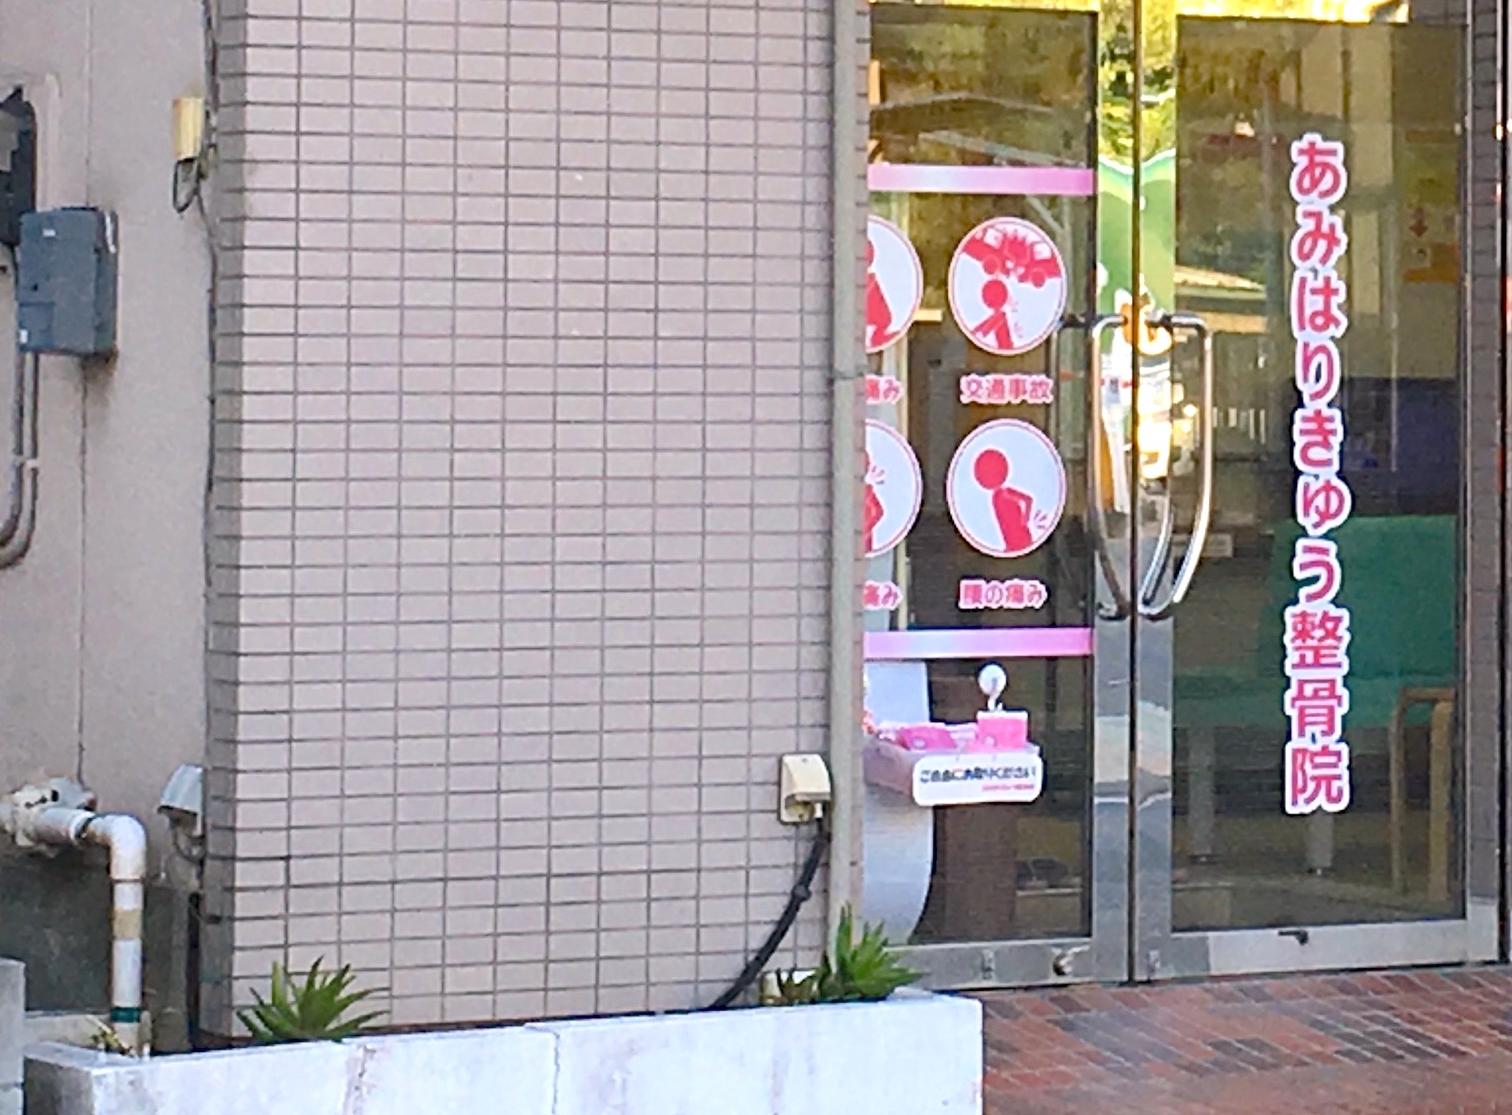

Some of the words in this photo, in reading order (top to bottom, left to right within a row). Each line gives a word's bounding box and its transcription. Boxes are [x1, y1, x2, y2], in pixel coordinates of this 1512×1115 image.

[965, 378, 1050, 400] 交通事故
[1290, 140, 1347, 805] あみはりきゅう整骨院
[962, 583, 1042, 604] 腰の痛み
